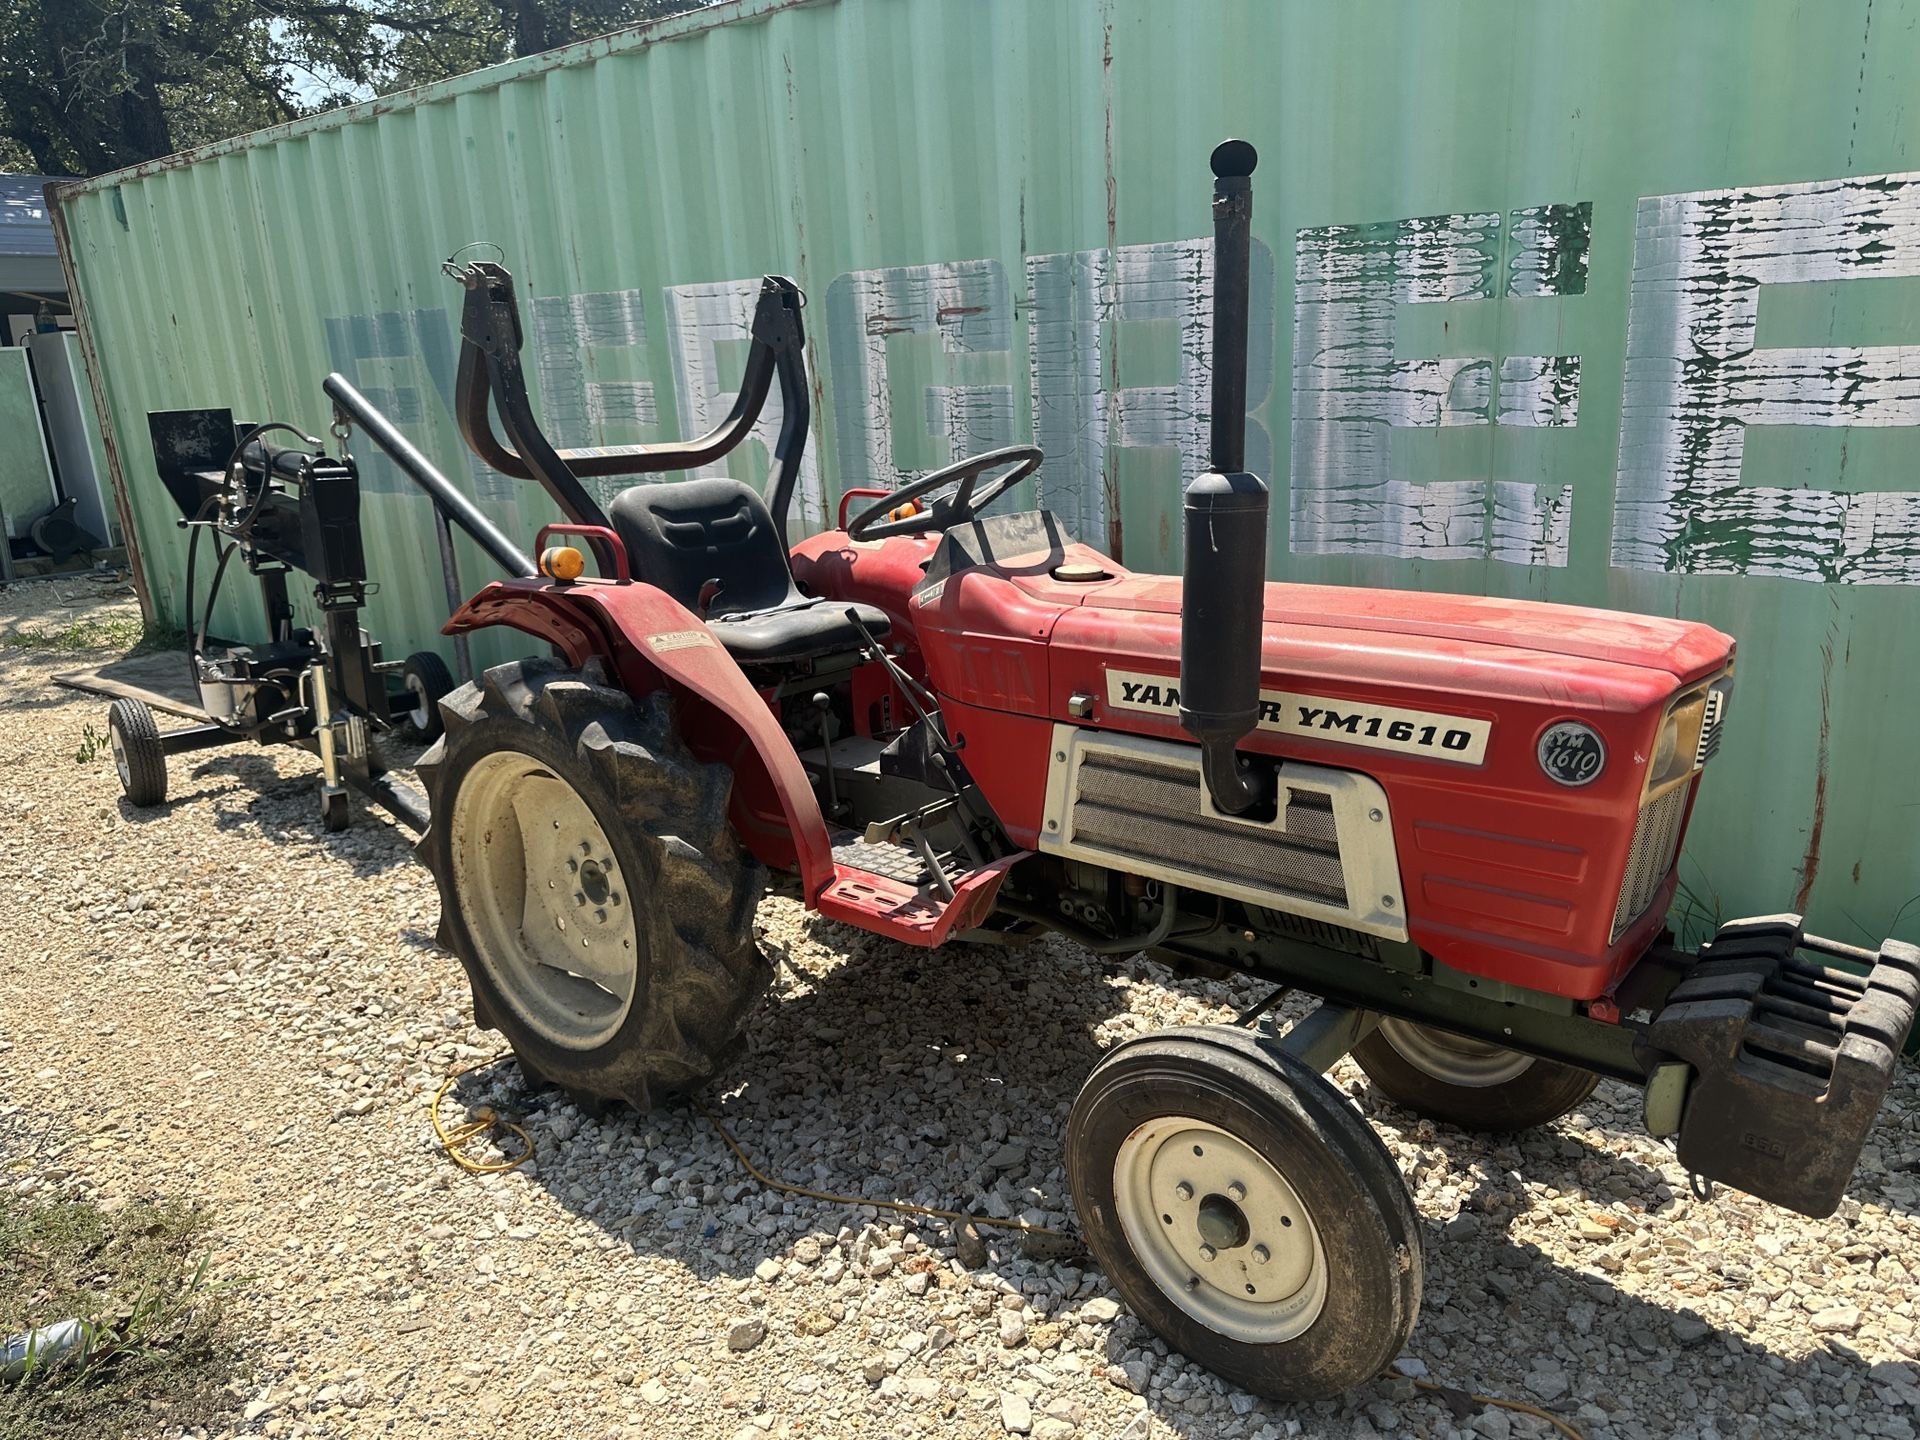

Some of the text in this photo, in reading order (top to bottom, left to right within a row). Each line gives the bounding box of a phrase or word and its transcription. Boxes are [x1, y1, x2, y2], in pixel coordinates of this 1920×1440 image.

[1121, 682, 1472, 751] YANR YM1610
[1554, 732, 1585, 748] YM
[1547, 747, 1597, 771] 1610
